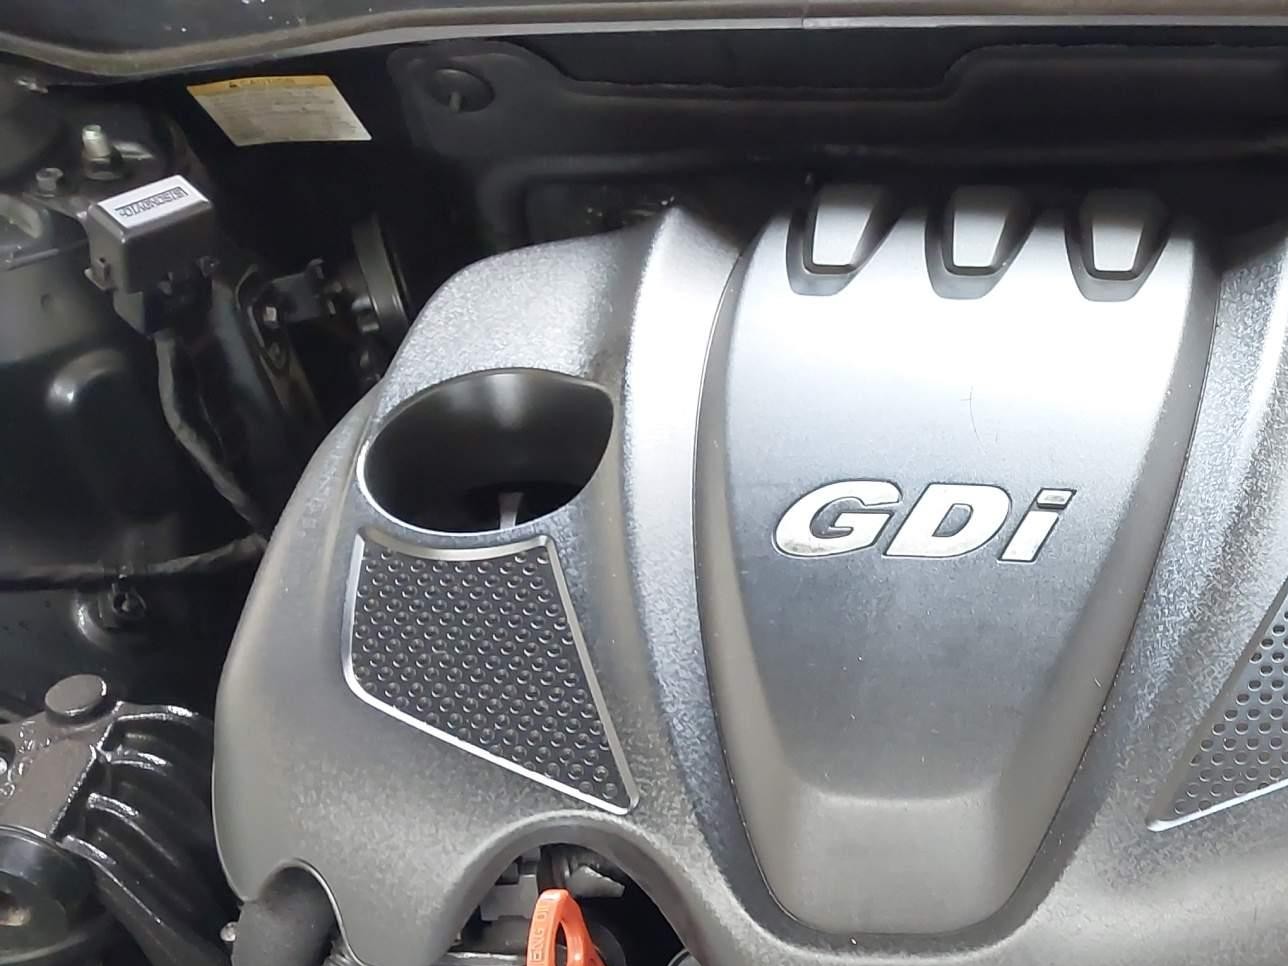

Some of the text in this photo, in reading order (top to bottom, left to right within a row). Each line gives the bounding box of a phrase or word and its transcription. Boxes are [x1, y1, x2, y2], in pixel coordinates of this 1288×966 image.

[121, 188, 184, 217] DIAGNOSIS
[772, 479, 1077, 563] GDi
[530, 926, 546, 963] ENG
